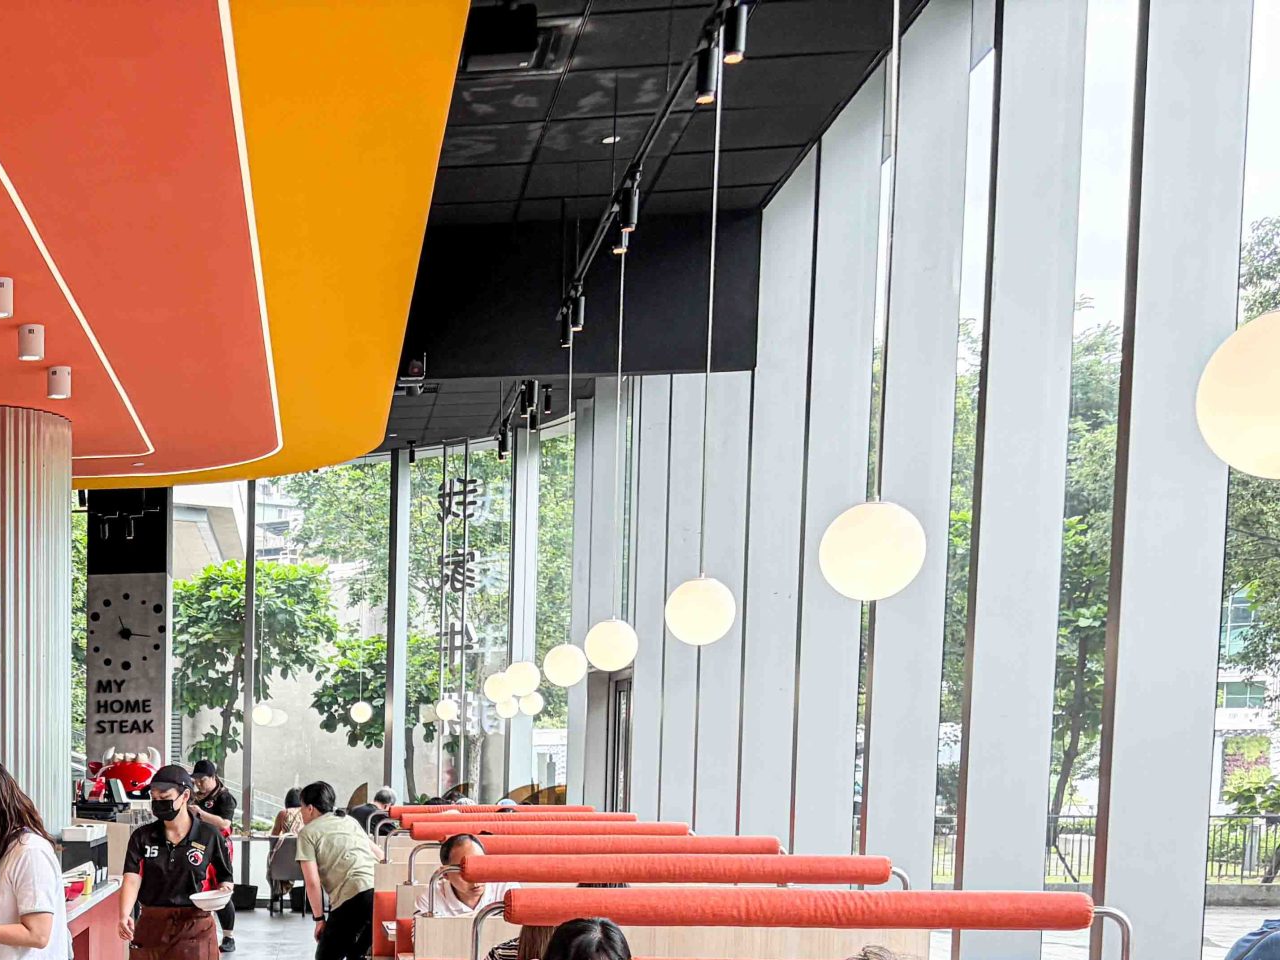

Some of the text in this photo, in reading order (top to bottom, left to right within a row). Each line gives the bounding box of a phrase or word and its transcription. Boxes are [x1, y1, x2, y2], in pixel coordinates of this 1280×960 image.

[96, 679, 126, 693] MY
[96, 699, 152, 714] HOME
[95, 720, 154, 734] STEAK
